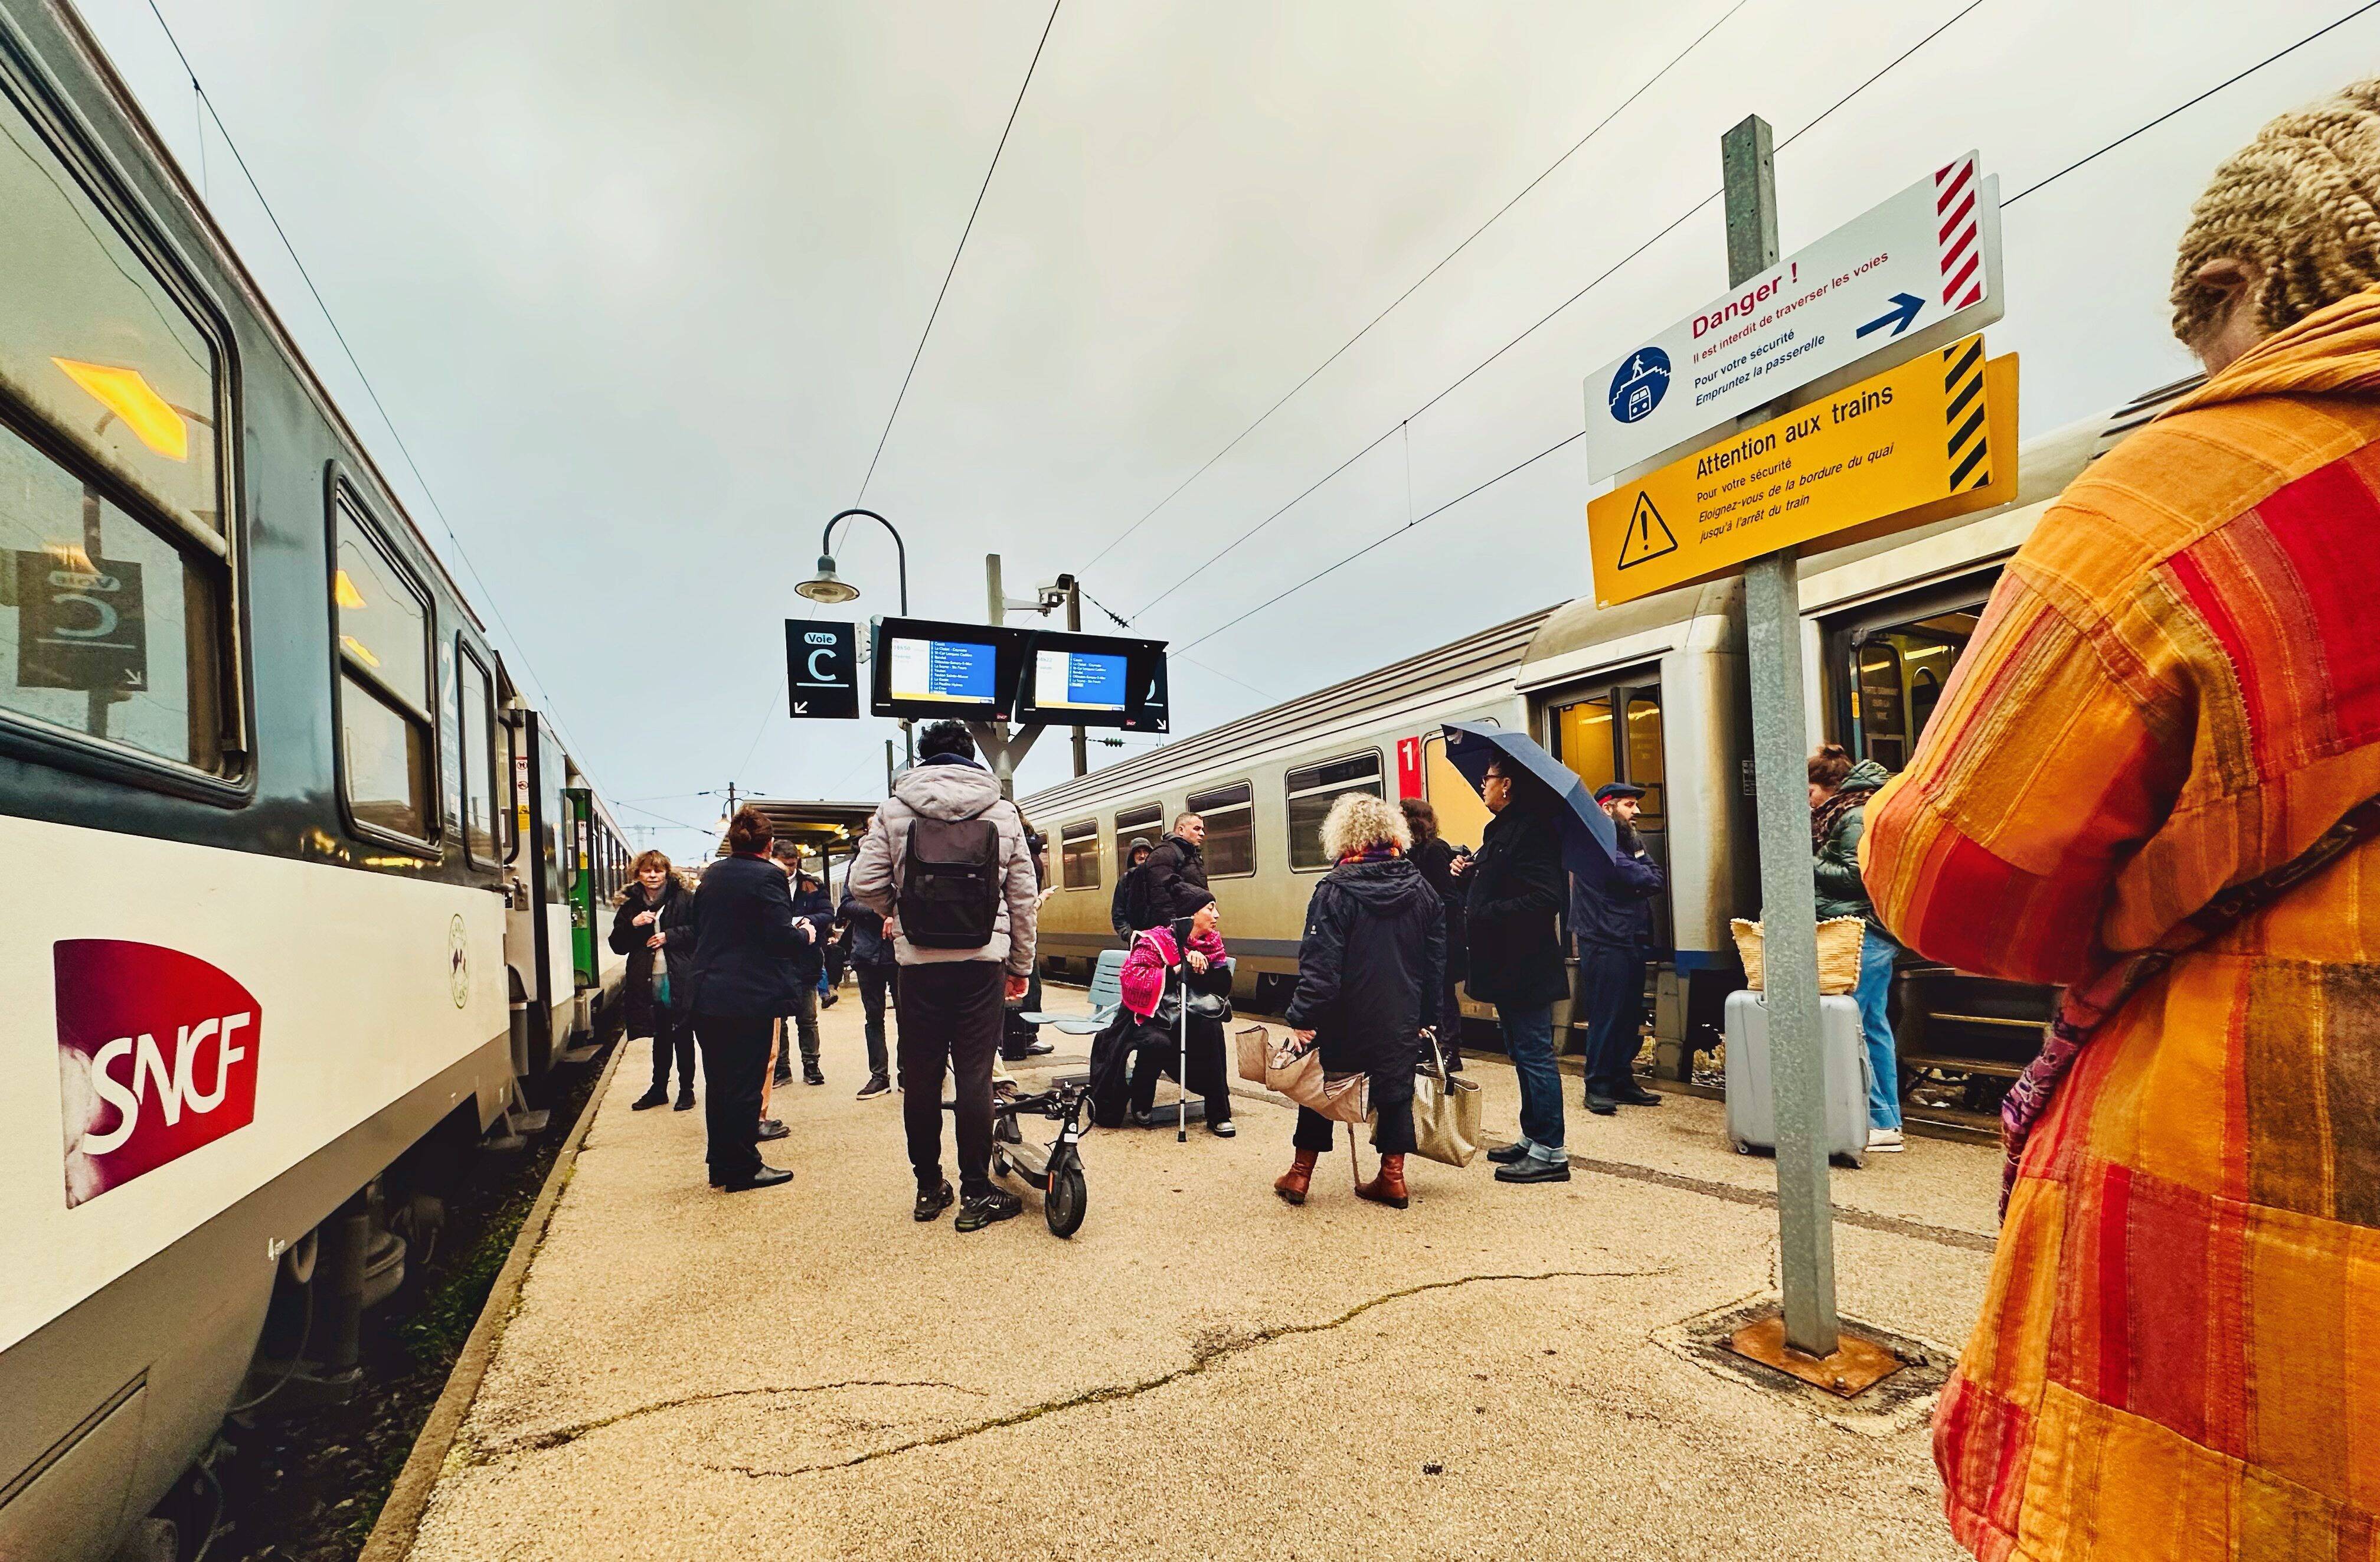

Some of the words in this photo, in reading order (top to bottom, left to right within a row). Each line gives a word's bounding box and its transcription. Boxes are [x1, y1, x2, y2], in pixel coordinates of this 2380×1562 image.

[1693, 276, 1782, 339] Danger
[1791, 262, 1797, 283] !
[1693, 352, 1699, 364] Il
[1702, 344, 1717, 359] est
[1719, 322, 1757, 349] interdit
[1759, 315, 1773, 328] de
[1776, 284, 1828, 319] traverser
[1832, 273, 1849, 289] les
[1853, 253, 1888, 277] voies
[1695, 369, 1718, 388] Pour
[1721, 355, 1747, 374] votre
[1750, 328, 1795, 360] sécurité
[1696, 372, 1750, 406] Empruntez
[1753, 366, 1763, 378] la
[1766, 335, 1825, 374] passerelle
[1696, 433, 1776, 480] Attention
[1784, 414, 1822, 443] aux
[1832, 386, 1893, 424] trains
[1696, 488, 1718, 503] Pour
[1722, 477, 1746, 493] votre
[1750, 457, 1792, 482] sécurité
[1699, 491, 1764, 523] Eloignez-vous
[1768, 484, 1781, 498] de
[1785, 479, 1795, 491] la
[1799, 463, 1843, 486] bordure
[1848, 455, 1863, 469] du
[1867, 442, 1895, 463] quai
[1699, 519, 1732, 544] jusqu'à
[1736, 508, 1765, 528] l'arrêt
[1768, 504, 1781, 517] du
[1786, 494, 1810, 511] train
[808, 633, 833, 643] Voie
[808, 648, 837, 681] C
[1402, 741, 1413, 771] 1
[82, 1011, 251, 1155] SNCF
